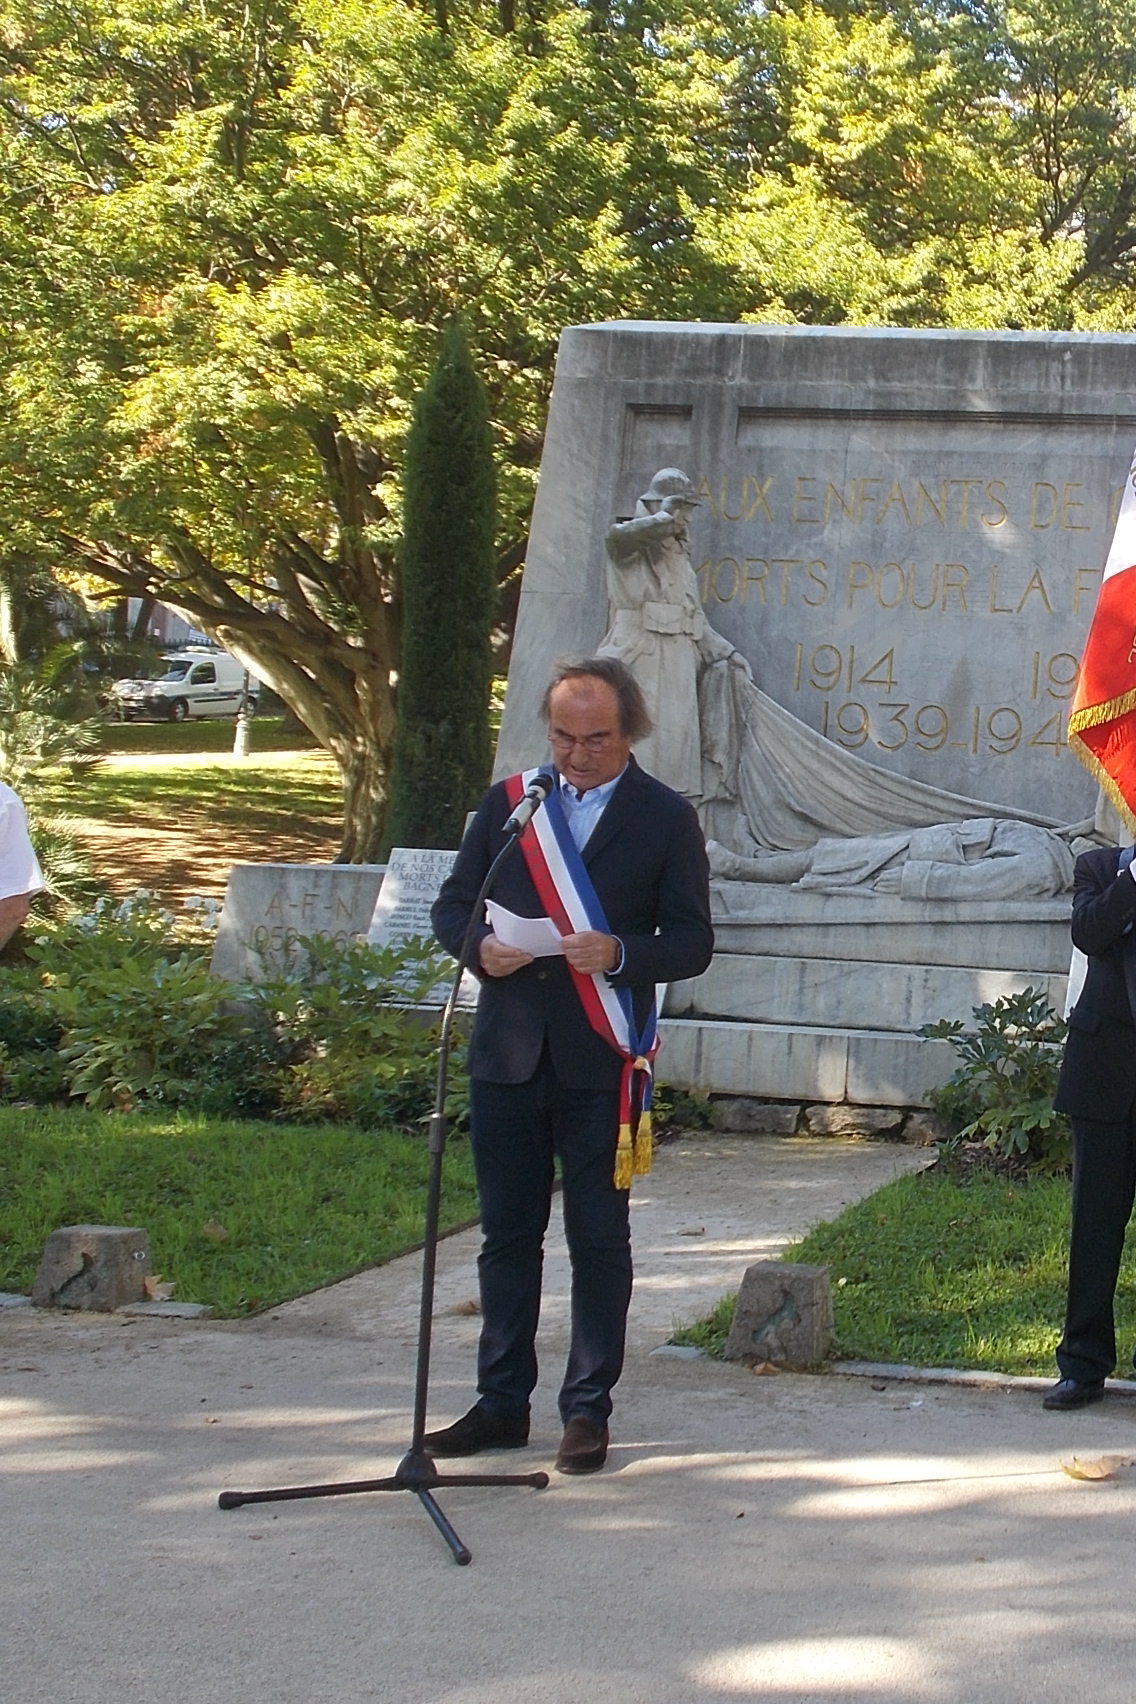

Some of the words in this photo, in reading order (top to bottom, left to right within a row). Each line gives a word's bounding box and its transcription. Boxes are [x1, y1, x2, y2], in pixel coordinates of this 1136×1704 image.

[697, 474, 776, 523] AUX
[793, 476, 1009, 529] ENFANTS
[1030, 480, 1091, 532] DE
[847, 560, 969, 613] POUR
[989, 564, 1055, 614] LA
[794, 643, 898, 694] 1914
[821, 701, 1069, 757] 1939-194
